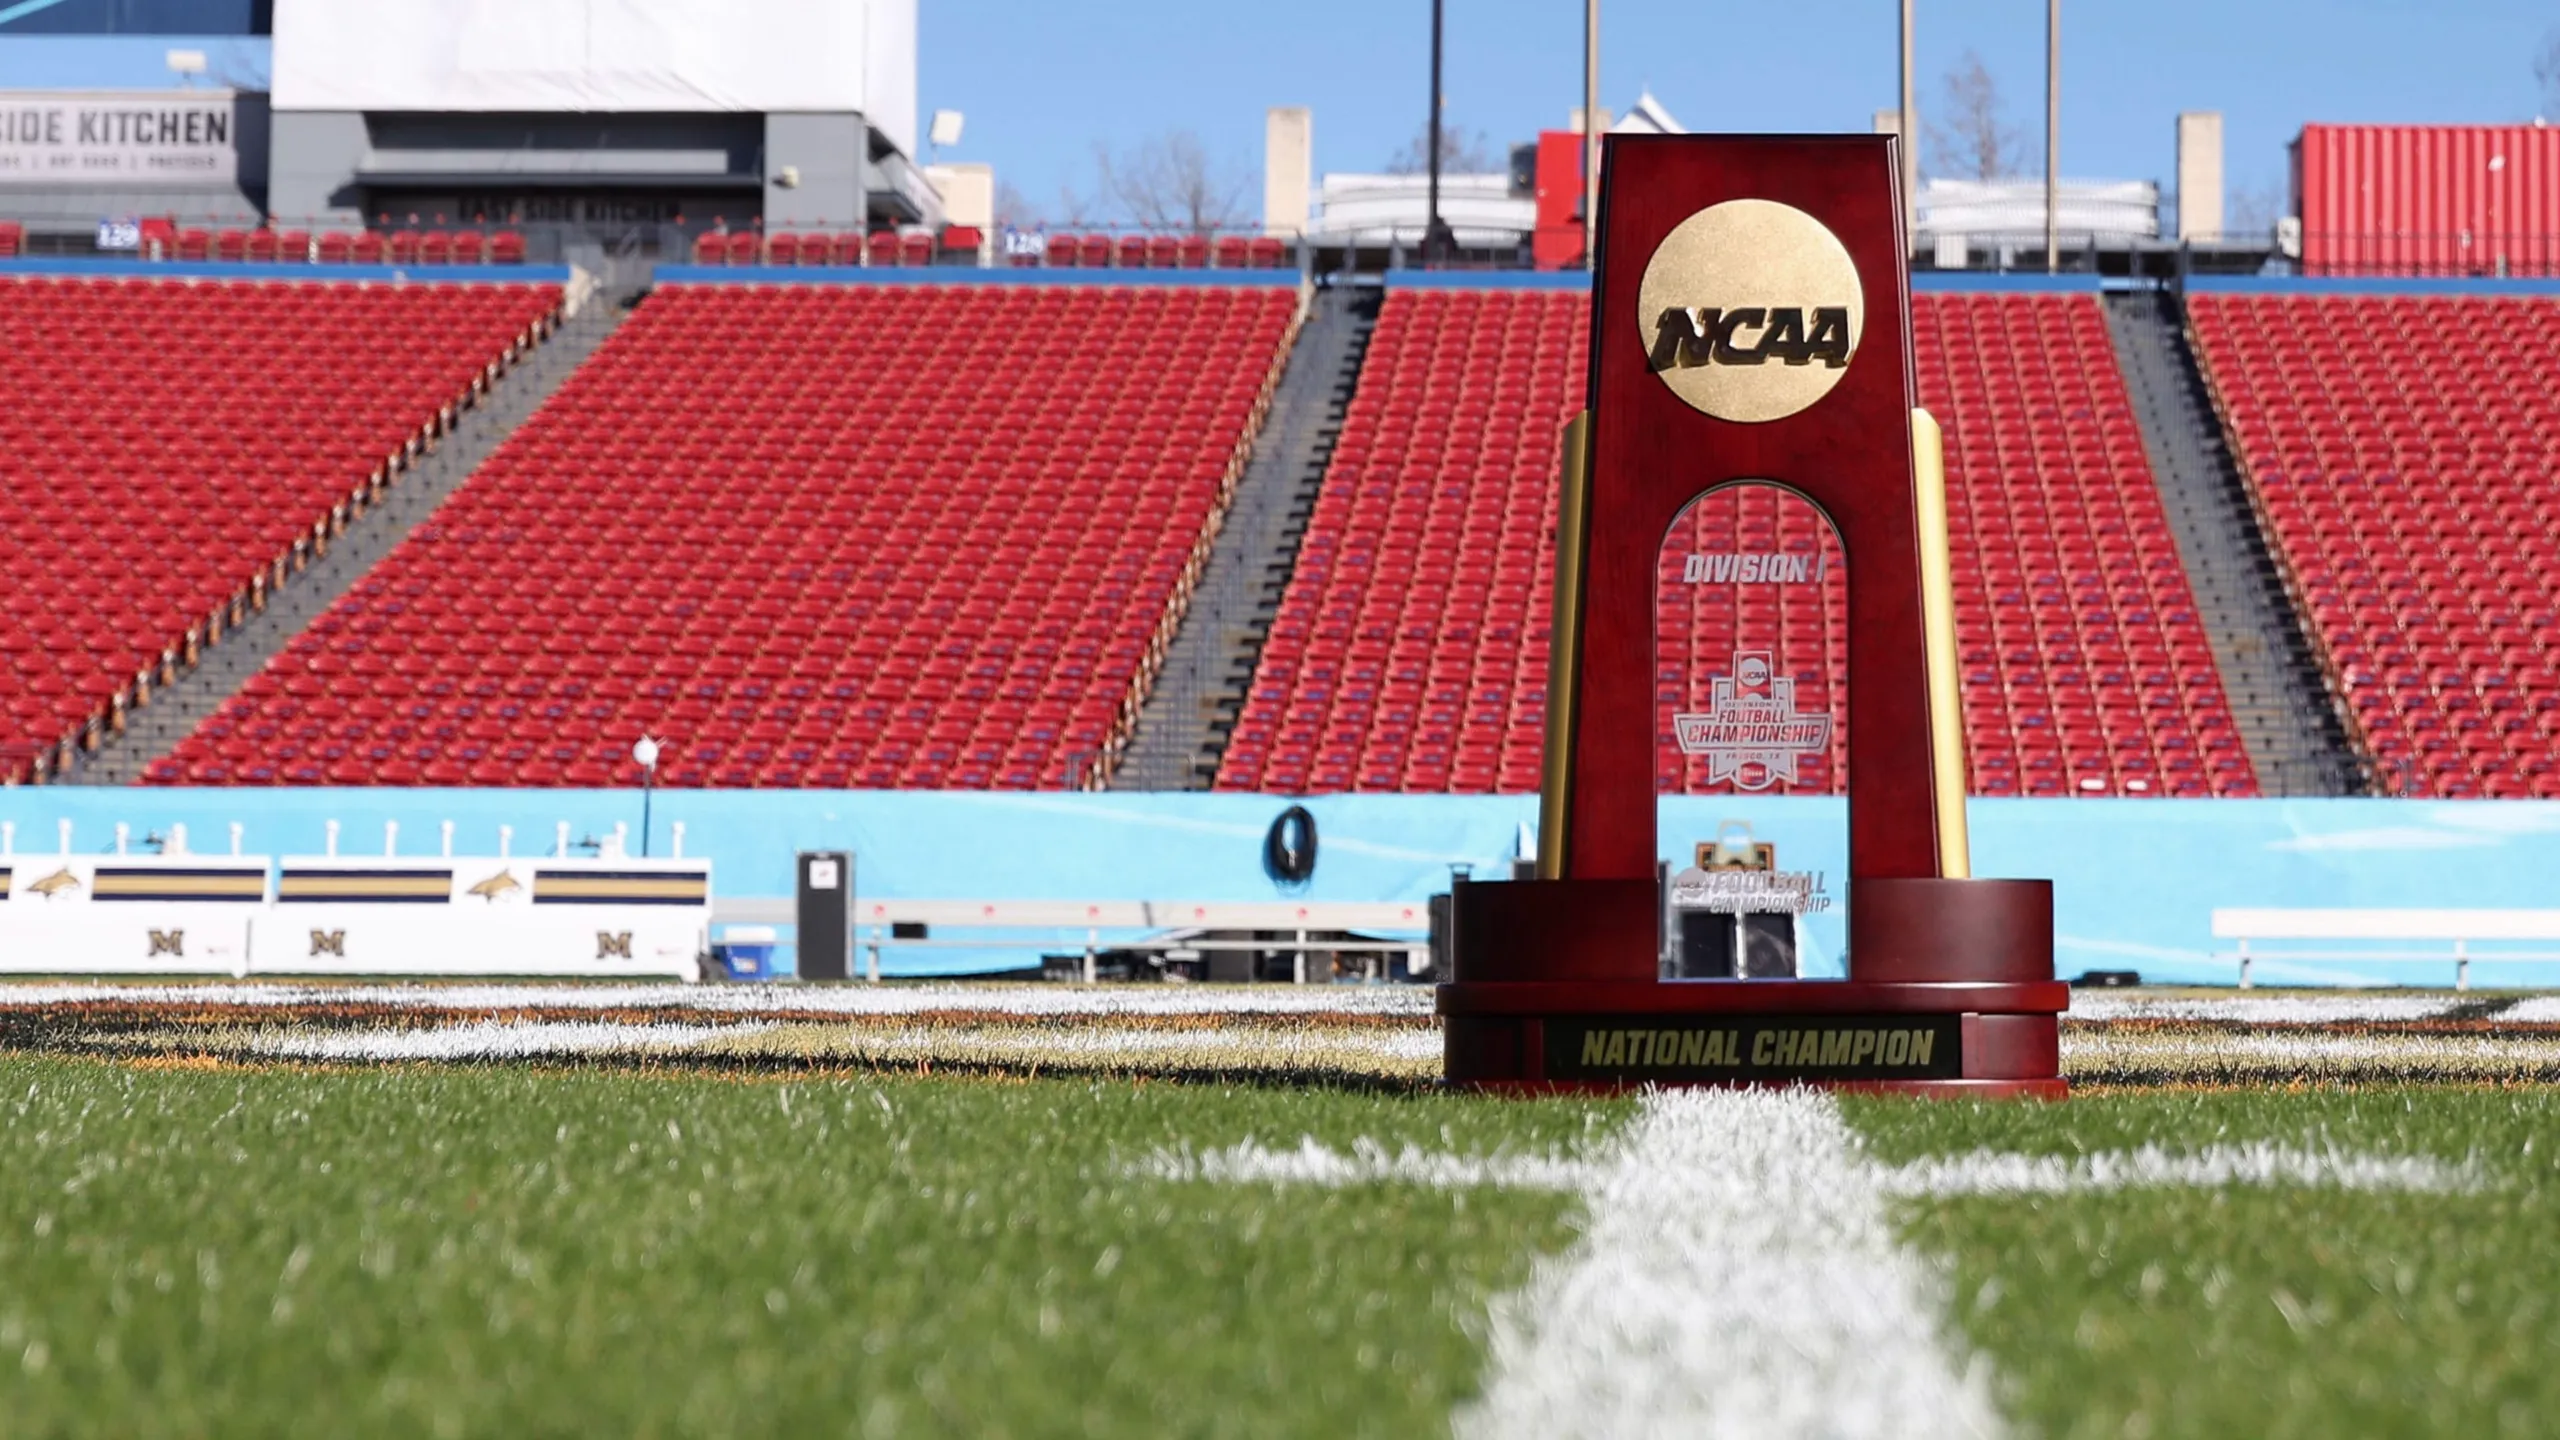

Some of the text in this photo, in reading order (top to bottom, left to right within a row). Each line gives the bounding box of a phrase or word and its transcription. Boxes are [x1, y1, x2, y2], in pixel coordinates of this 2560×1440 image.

[0, 111, 227, 144] IDE KITCHEN
[1648, 307, 1851, 369] NCAA
[1684, 554, 1809, 583] DIVISION
[1719, 709, 1786, 724] FOOTBALL
[1688, 725, 1822, 743] CHAMPIONSHIP
[1711, 871, 1827, 894] FOOTBALL
[1710, 896, 1831, 914] CHAMPIONSHIP
[1581, 1029, 1935, 1067] NATIONAL CHAMPION
